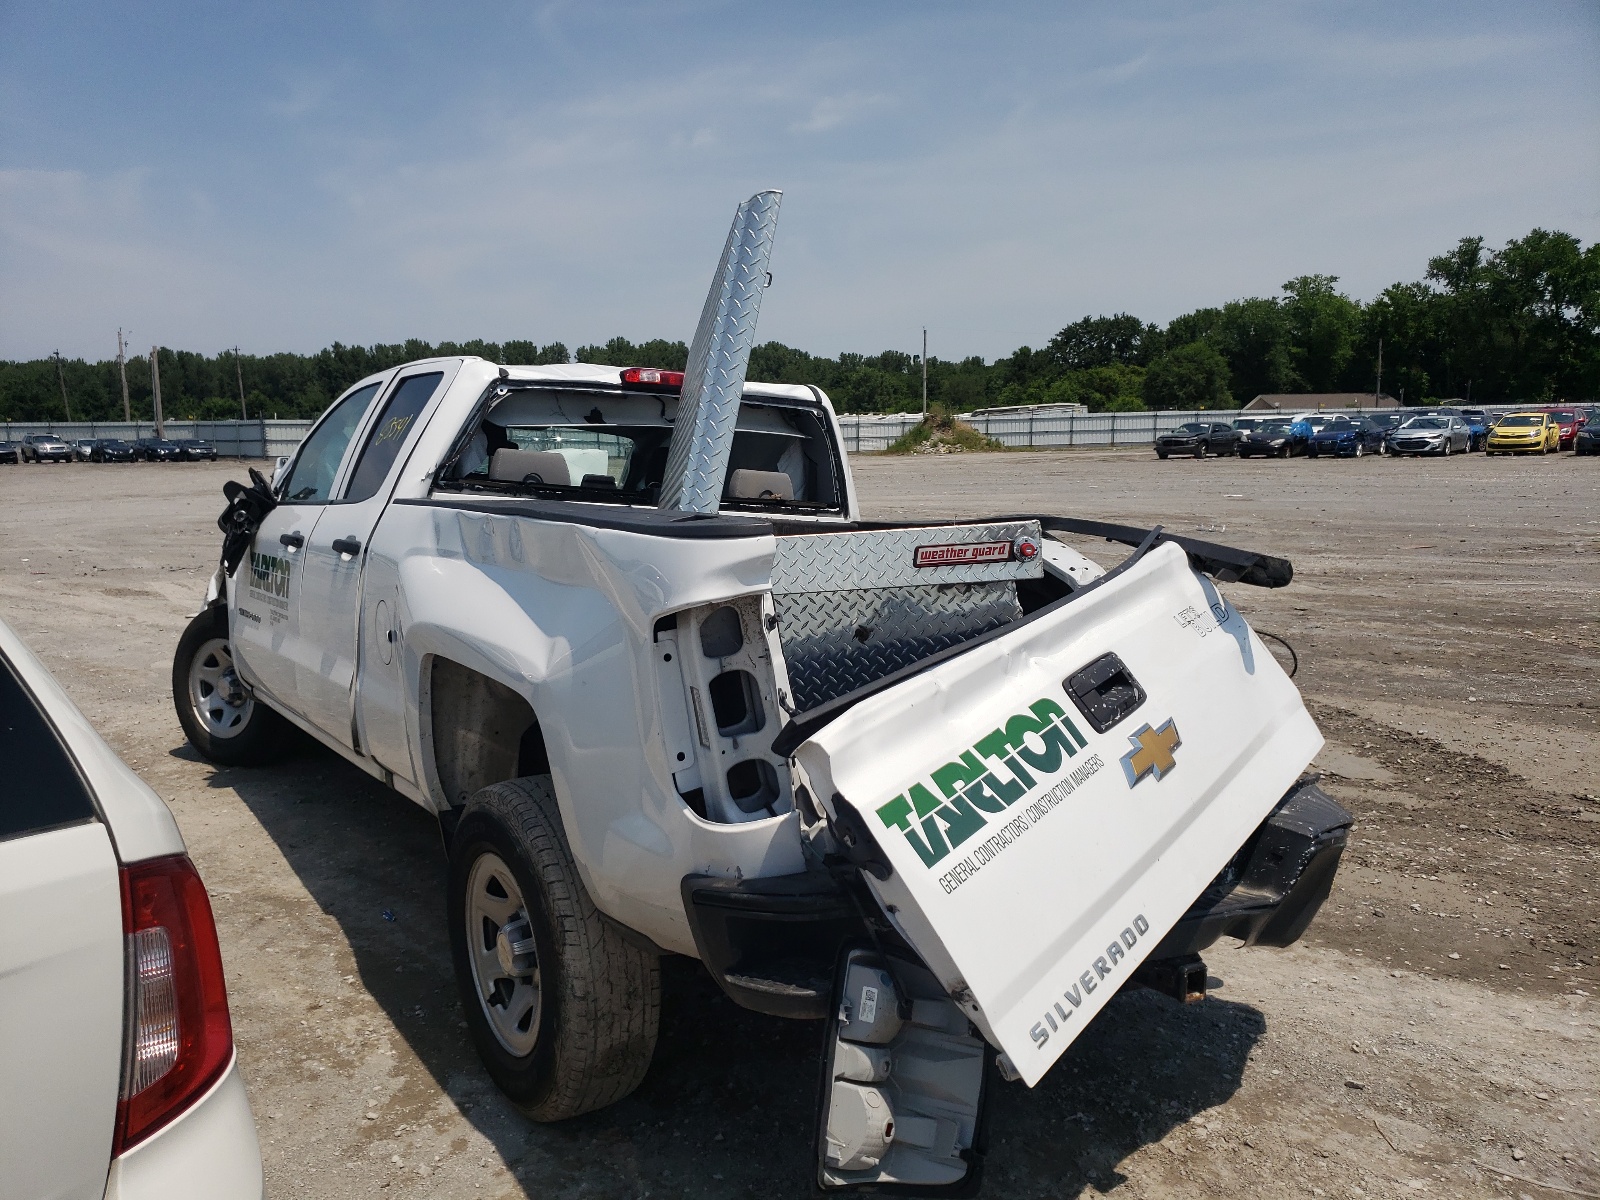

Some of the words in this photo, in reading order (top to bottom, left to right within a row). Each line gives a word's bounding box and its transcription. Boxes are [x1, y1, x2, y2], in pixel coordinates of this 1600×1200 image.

[920, 547, 968, 561] weather
[971, 544, 1006, 559] guard
[875, 698, 1089, 870] TARLTON
[938, 856, 981, 895] GENERAL
[973, 815, 1029, 867] CONTRACTORS
[1025, 775, 1076, 824] CONSTRUCTION
[1069, 753, 1105, 787] MANAGERS
[1029, 913, 1150, 1050] SILVERADO
